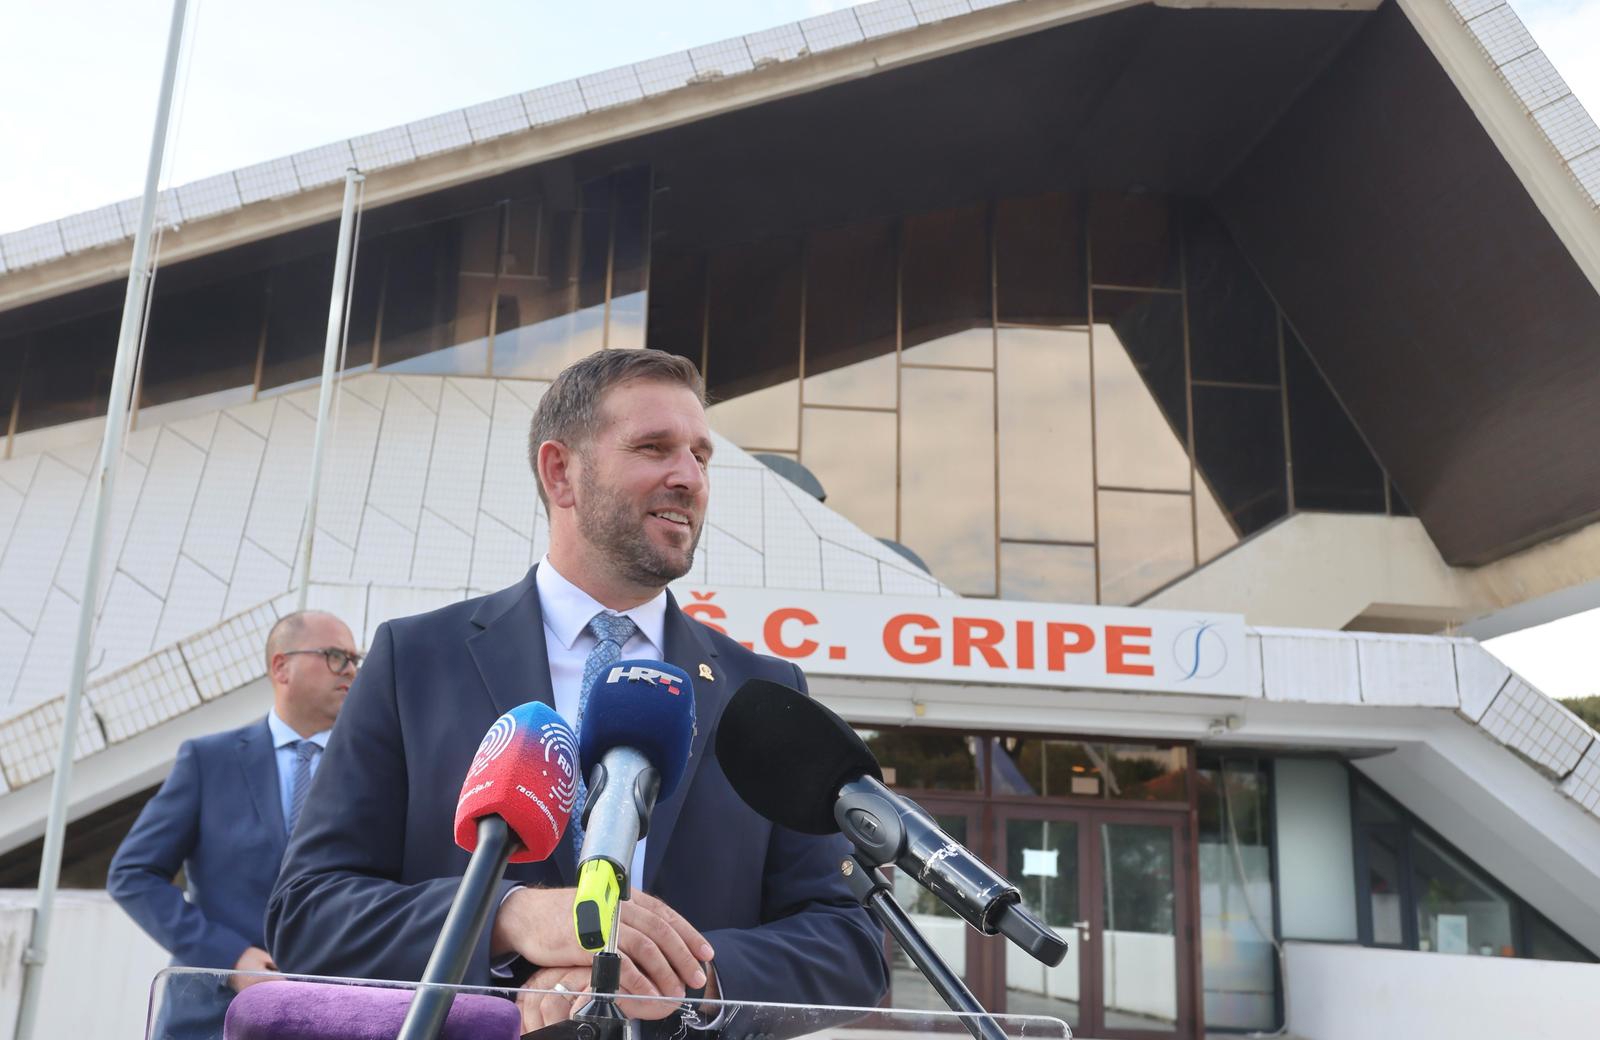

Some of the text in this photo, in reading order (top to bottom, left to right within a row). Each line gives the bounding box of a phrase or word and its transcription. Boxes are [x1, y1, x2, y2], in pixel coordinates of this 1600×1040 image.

[882, 613, 1155, 677] GRIPE
[606, 666, 683, 695] HRT
[557, 753, 573, 778] RD
